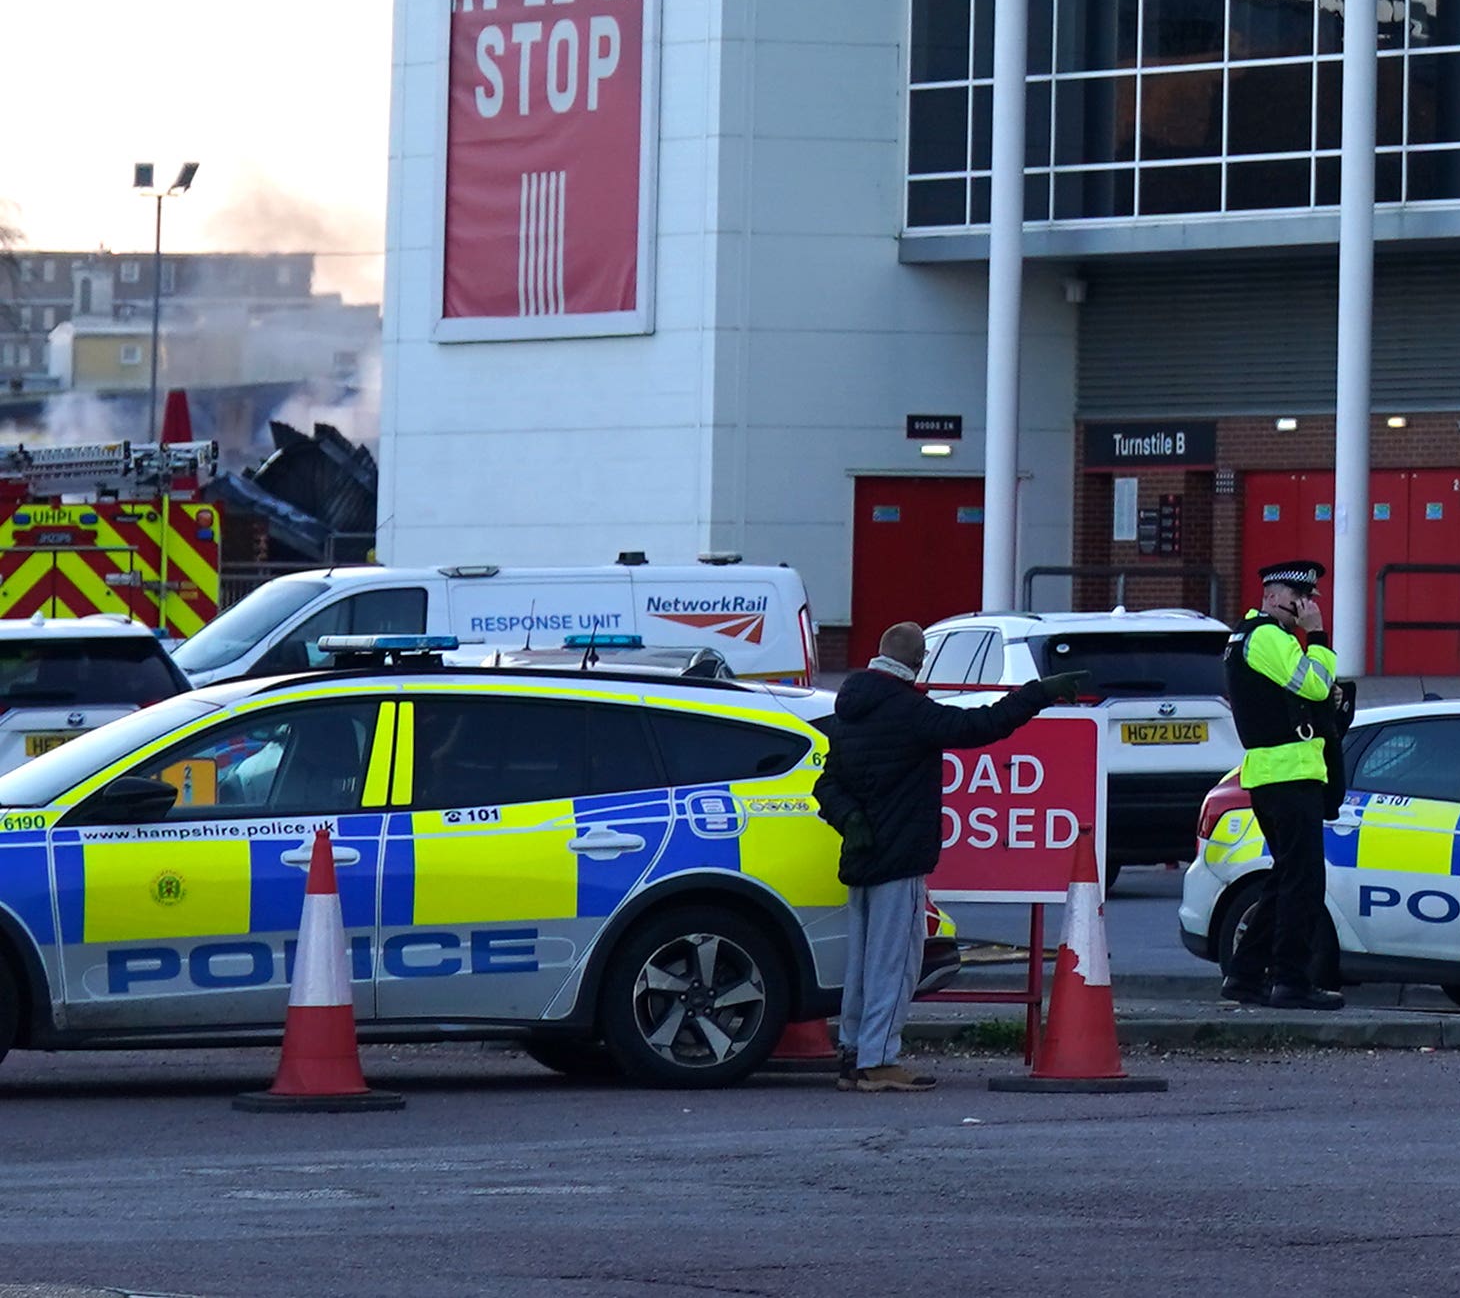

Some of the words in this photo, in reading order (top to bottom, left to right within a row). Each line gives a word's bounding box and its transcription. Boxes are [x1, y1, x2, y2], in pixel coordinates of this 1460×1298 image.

[475, 15, 621, 118] STOP
[1113, 432, 1173, 456] Turnstile
[1176, 432, 1185, 453] B
[646, 596, 768, 612] NetworkRail
[471, 615, 572, 632] RESPONSE
[579, 613, 622, 629] UNIT
[1128, 724, 1167, 740] HG72
[1173, 724, 1202, 740] UZC
[942, 753, 1044, 794] OAD
[1389, 796, 1410, 806] 101
[4, 815, 46, 831] 6190
[468, 808, 500, 822] 101
[83, 820, 336, 841] www.hampshire.police.uk
